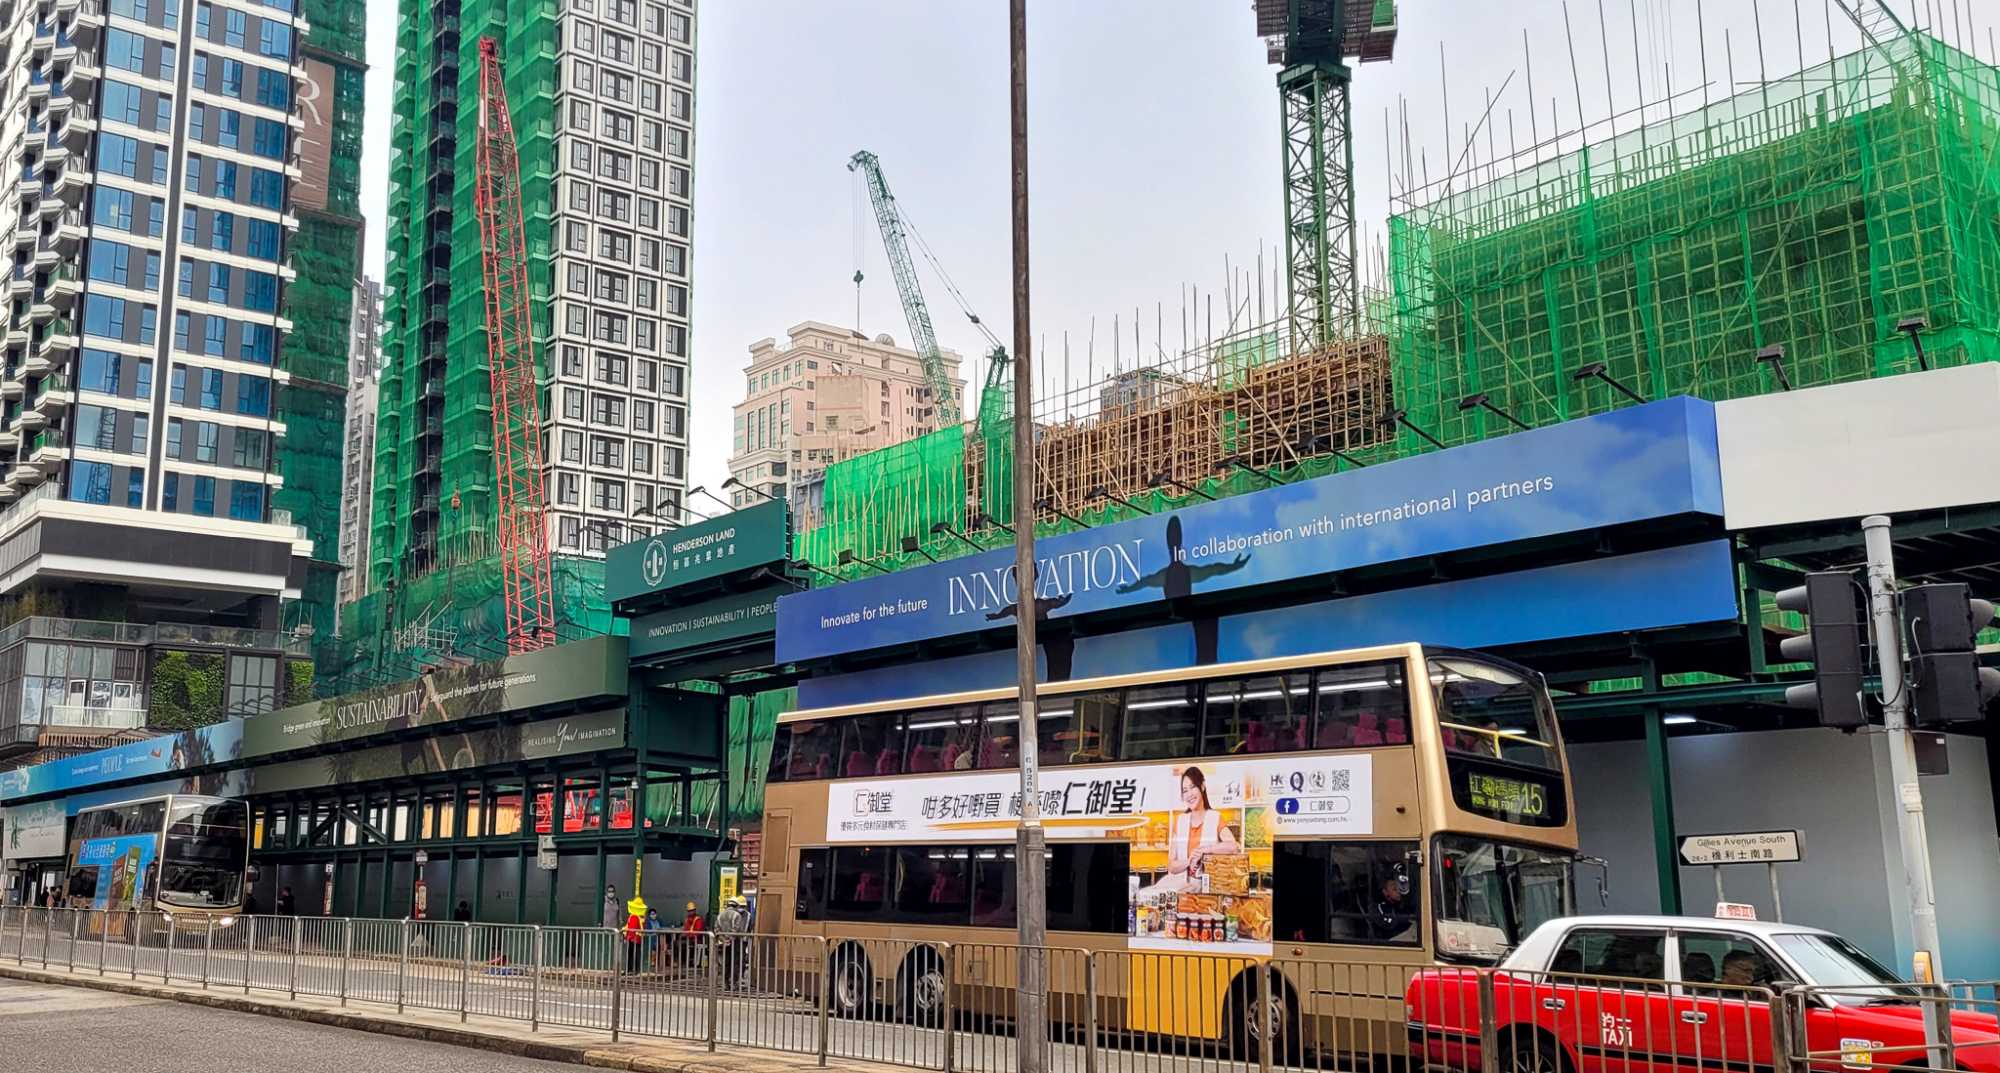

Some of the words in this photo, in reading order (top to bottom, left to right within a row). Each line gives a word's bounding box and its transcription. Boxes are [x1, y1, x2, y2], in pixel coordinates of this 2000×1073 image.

[1173, 545, 1187, 562] In
[1192, 526, 1294, 558] collaboration
[1299, 513, 1334, 538] with
[1339, 488, 1457, 530] international
[1467, 475, 1554, 512] partners
[672, 533, 714, 554] HENDERSON
[716, 527, 736, 542] LAND
[948, 539, 1145, 617] INNOVATION
[648, 621, 689, 638] INNOVATION
[692, 608, 745, 630] SUSTAINABILITY
[751, 601, 778, 616] PEOPLE
[821, 611, 861, 629] Innovate
[863, 606, 877, 621] for
[879, 602, 896, 617] the
[898, 598, 928, 614] future
[454, 686, 463, 697] the
[463, 682, 480, 697] planet
[480, 680, 488, 691] for
[488, 678, 504, 690] future
[504, 672, 536, 689] generations
[336, 688, 423, 730] SUSTAINABILITY
[577, 727, 617, 741] IMAGINATION
[1521, 782, 1544, 815] 15
[1724, 837, 1757, 847] Avenue
[1760, 834, 1787, 844] South
[1601, 1011, 1633, 1030] 的士
